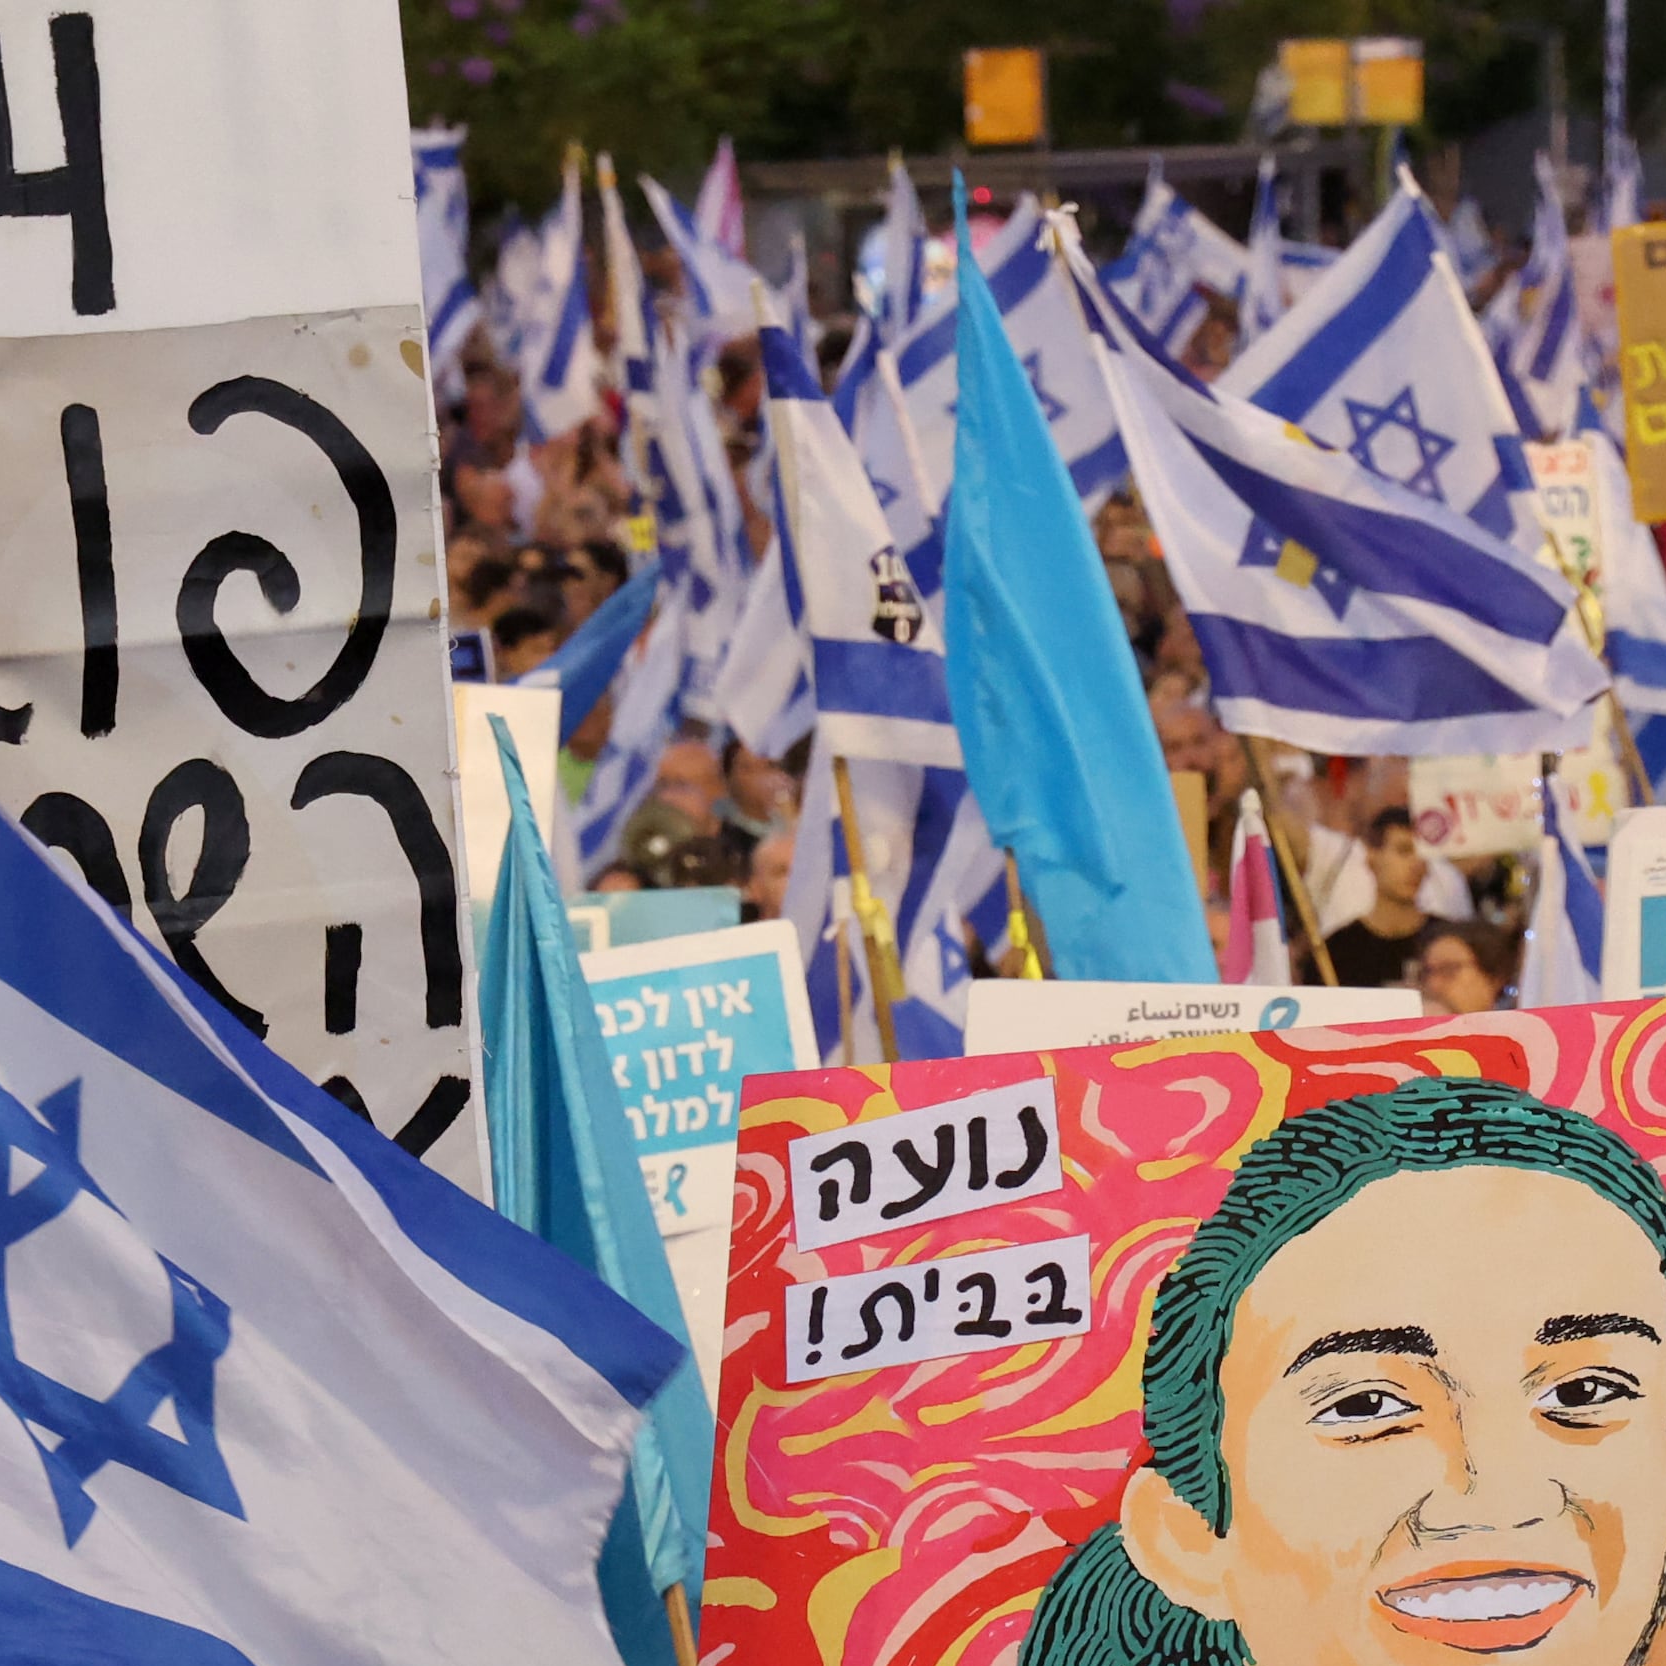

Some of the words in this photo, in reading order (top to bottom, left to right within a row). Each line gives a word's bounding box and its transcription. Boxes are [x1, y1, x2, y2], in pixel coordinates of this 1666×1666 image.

[683, 979, 754, 1029] אין
[1186, 1001, 1241, 1020] נשים
[640, 1029, 734, 1091] לדון
[810, 1103, 1051, 1220] נועה
[802, 1259, 1083, 1367] בבית!
